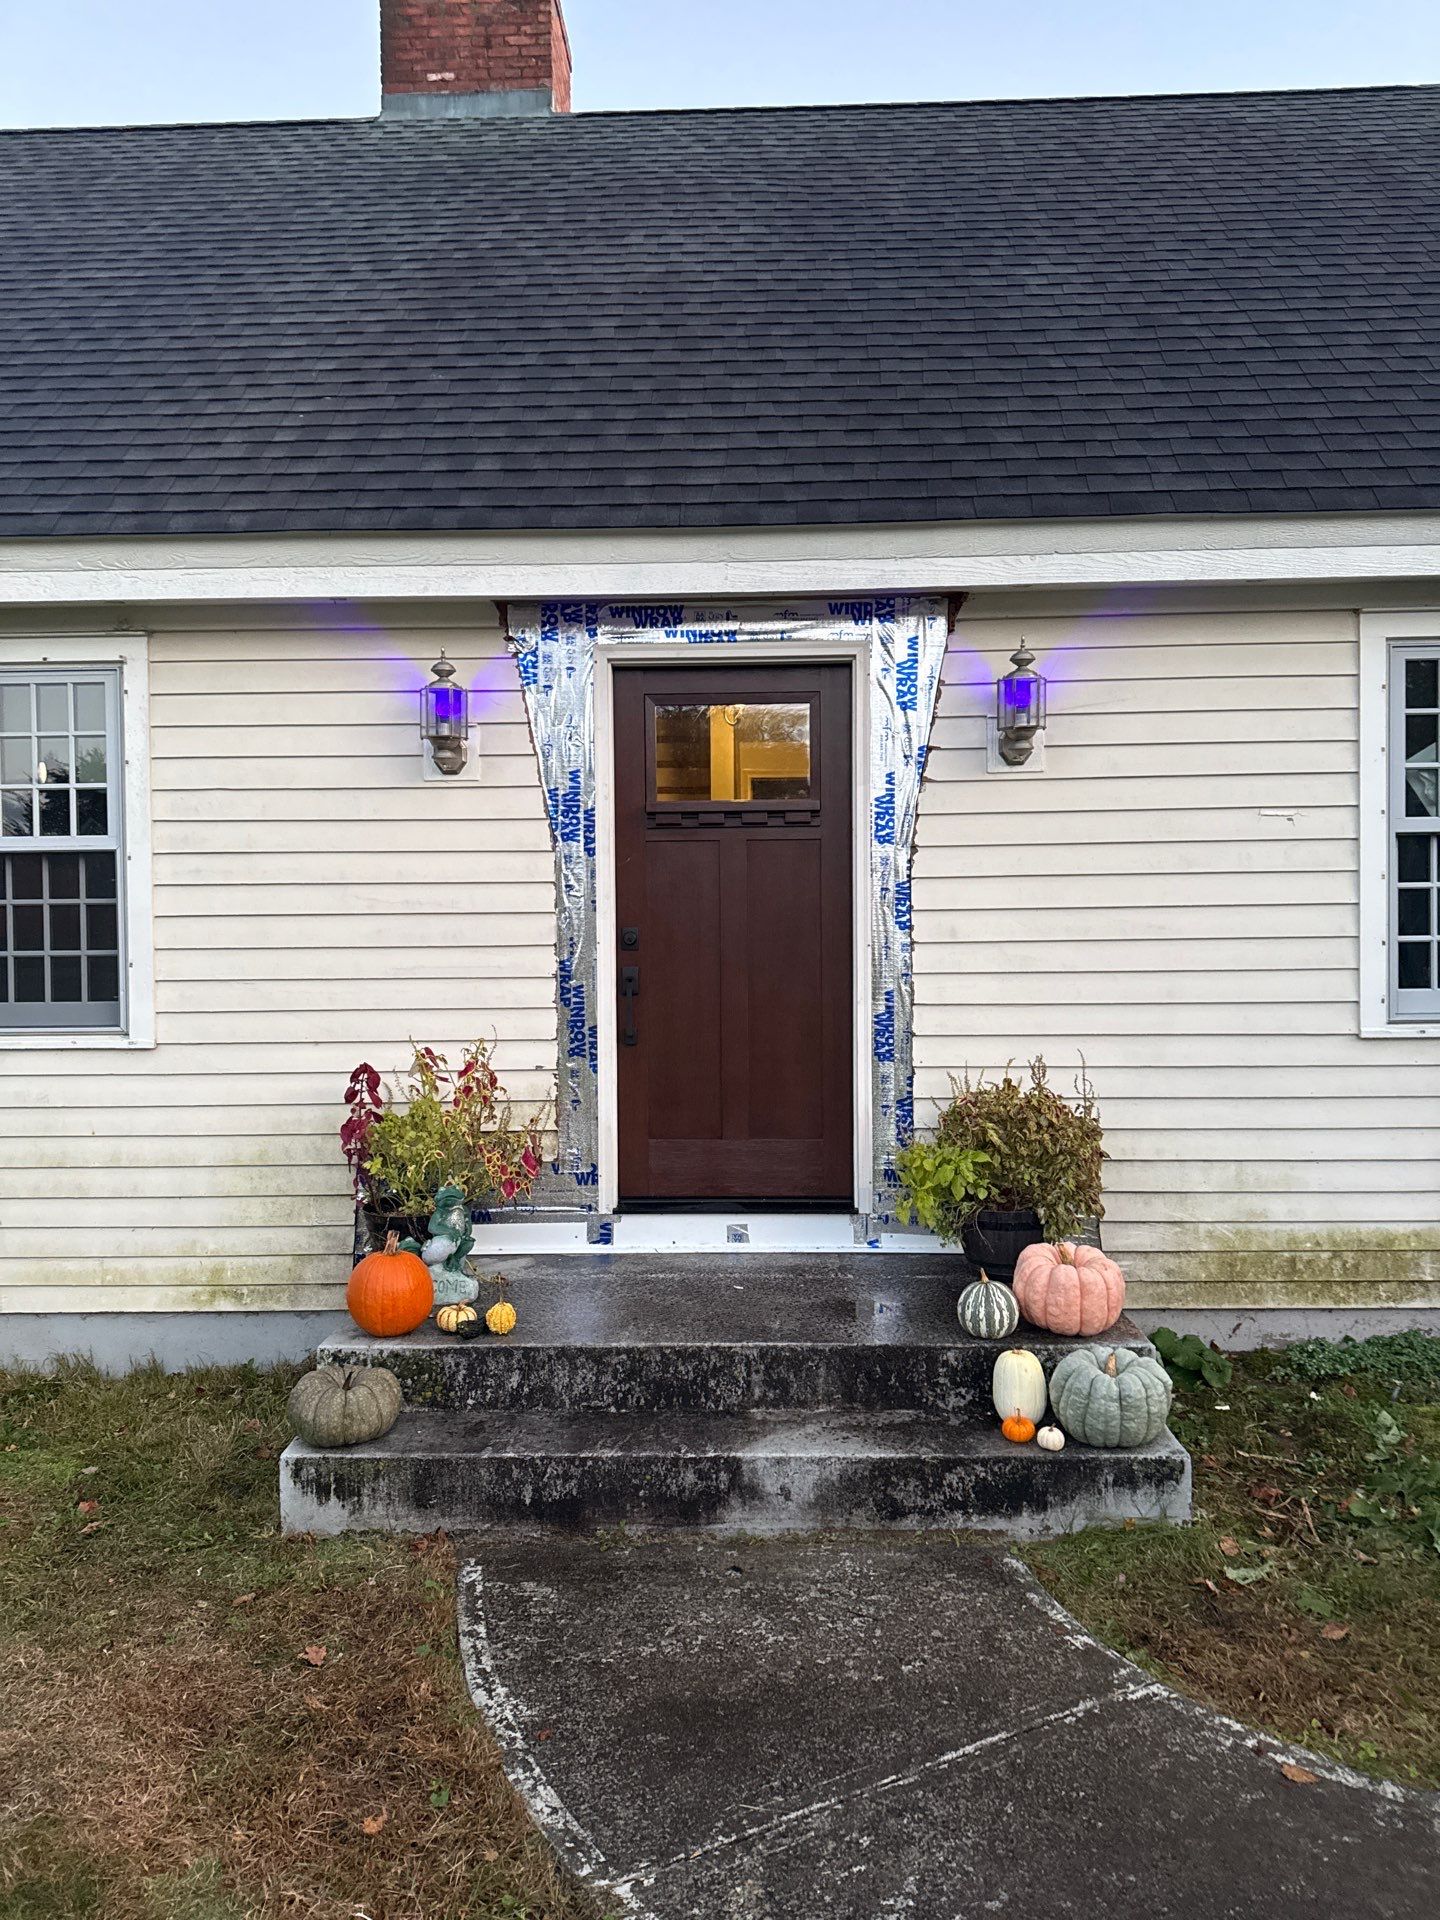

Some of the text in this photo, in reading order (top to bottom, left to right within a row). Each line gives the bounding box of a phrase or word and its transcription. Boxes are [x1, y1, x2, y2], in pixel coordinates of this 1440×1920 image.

[609, 604, 685, 619] WINDOW
[633, 616, 684, 629] WRAP
[896, 661, 909, 711] WRAP
[906, 635, 919, 712] WINDOW
[568, 768, 581, 844] WINDOW
[874, 795, 887, 846] WRAP
[885, 771, 896, 846] WINDOW
[584, 807, 596, 858] WRAP
[894, 880, 910, 931] WRAP
[559, 959, 572, 1008] WRAP
[570, 983, 587, 1059] WINDOW
[874, 1011, 886, 1063] WRAP
[884, 989, 895, 1063] WINDOW
